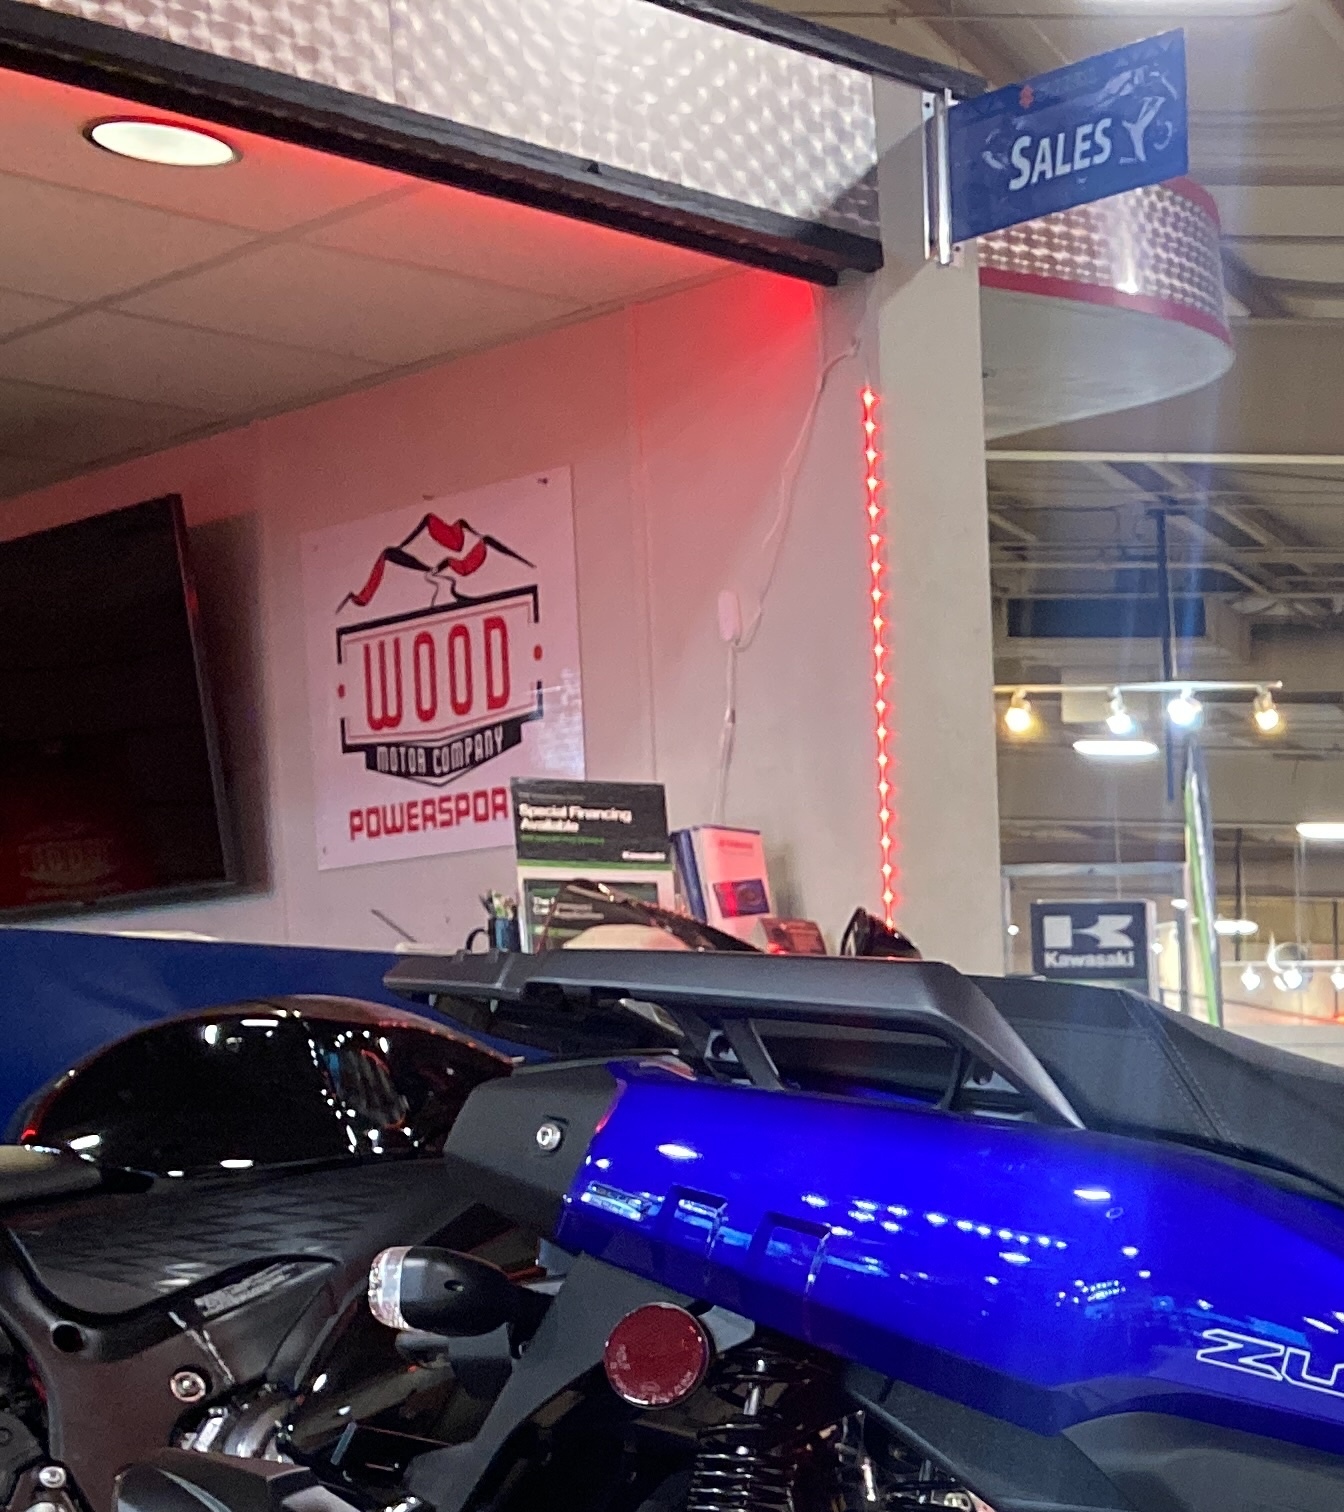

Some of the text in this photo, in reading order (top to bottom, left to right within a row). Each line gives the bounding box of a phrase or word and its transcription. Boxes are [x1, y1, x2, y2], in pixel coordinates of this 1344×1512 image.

[1008, 117, 1113, 191] SALES
[363, 615, 511, 731] WOOD
[376, 725, 504, 776] MOTOR COMPANY
[350, 786, 510, 840] POWERSPOR
[519, 803, 632, 824] Special Financing
[1044, 949, 1135, 968] Kawasaki
